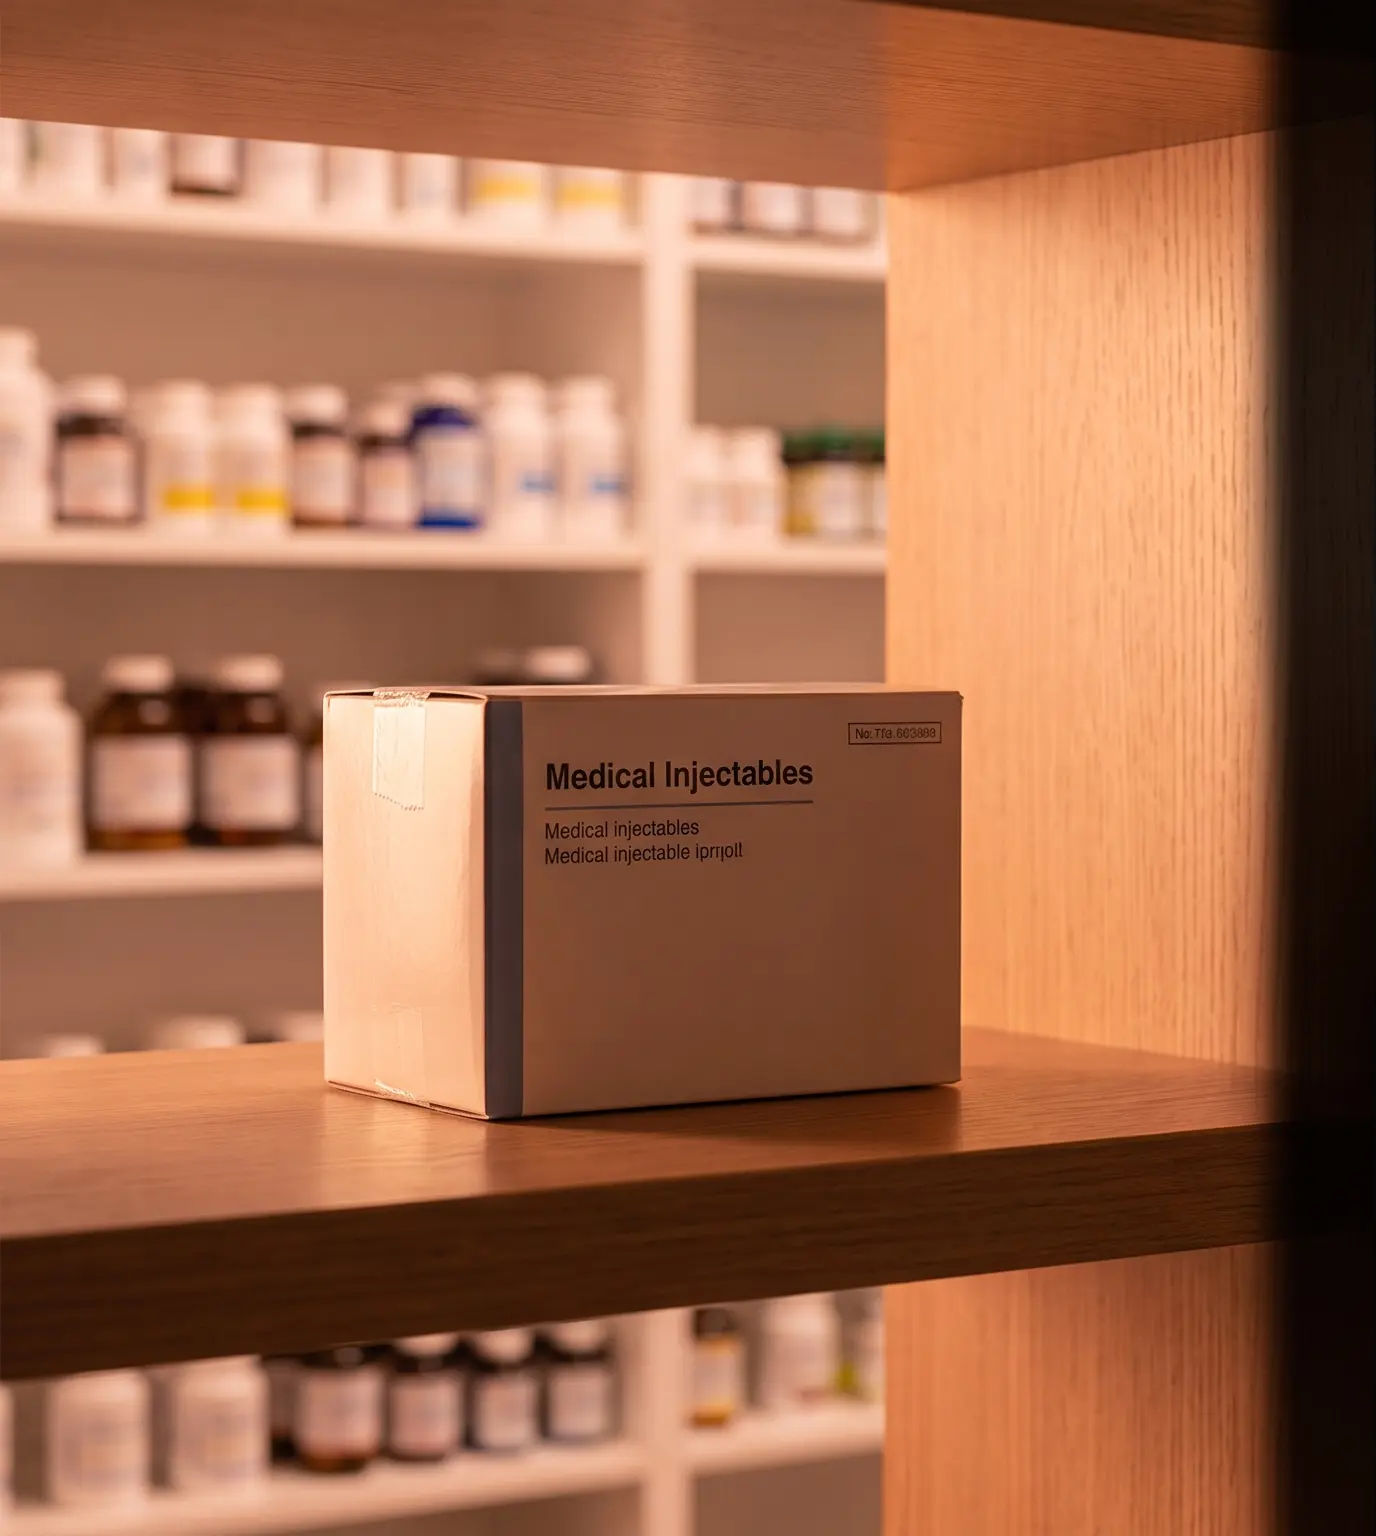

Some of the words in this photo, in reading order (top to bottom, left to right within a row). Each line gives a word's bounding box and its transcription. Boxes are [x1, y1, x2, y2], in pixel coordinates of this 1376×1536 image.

[546, 761, 655, 790] Medical
[665, 759, 813, 794] Injectables
[545, 821, 608, 839] Medical
[614, 819, 700, 841] injectables
[545, 846, 608, 864] Medical
[614, 844, 690, 866] injectable
